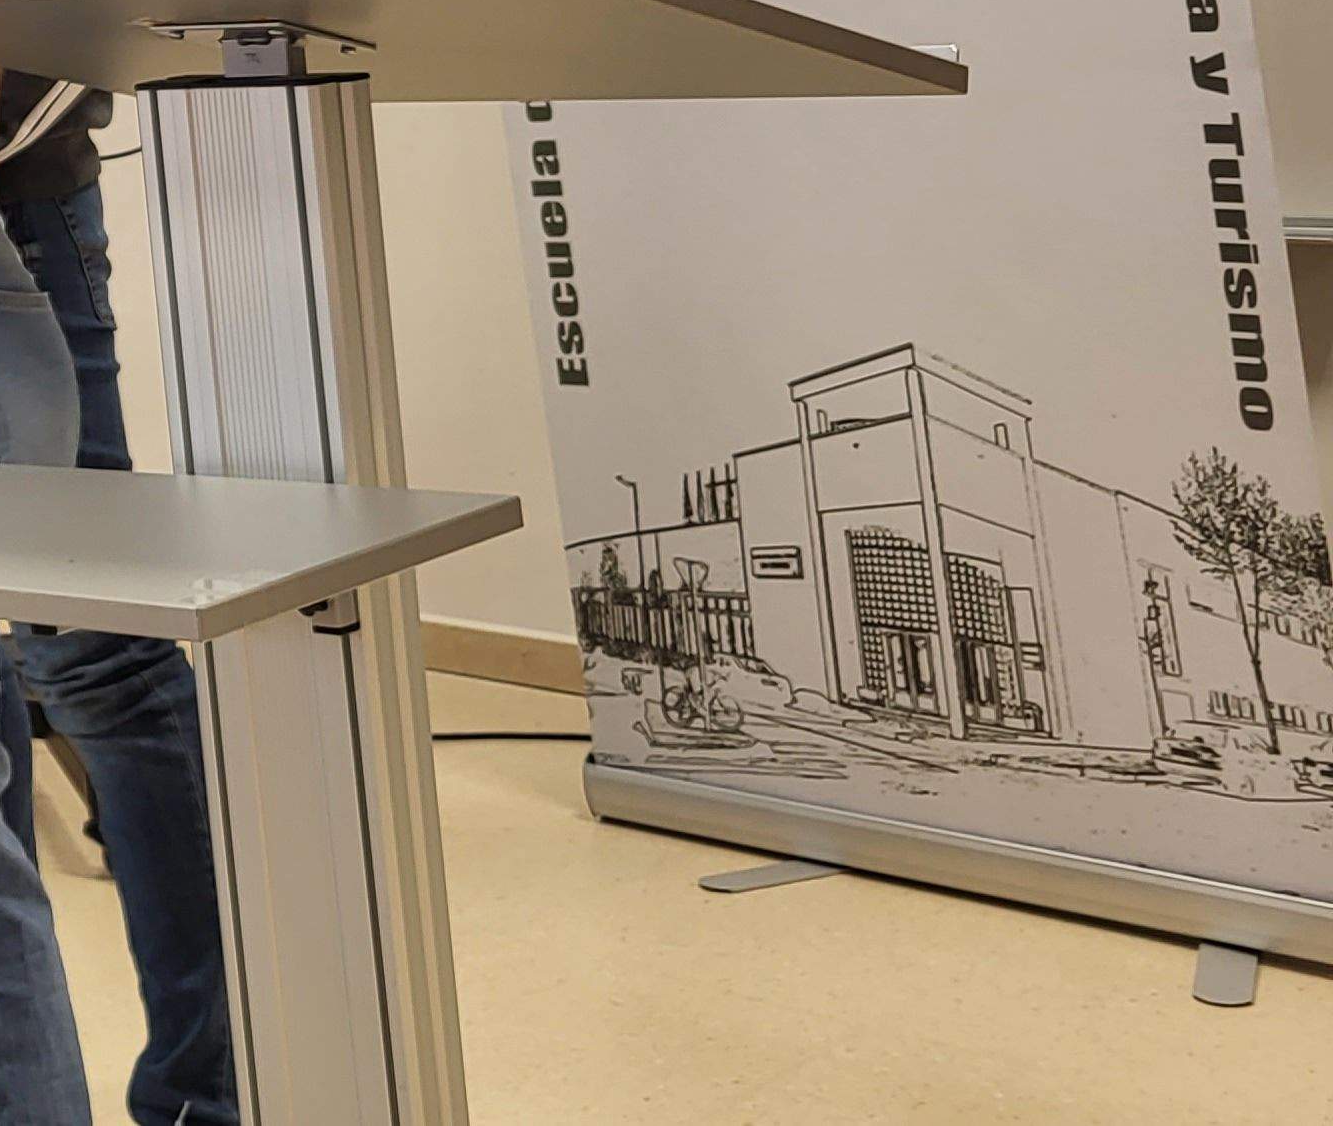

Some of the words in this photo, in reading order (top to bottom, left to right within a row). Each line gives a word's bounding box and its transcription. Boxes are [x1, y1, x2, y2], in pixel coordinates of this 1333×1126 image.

[1189, 51, 1230, 96] y
[531, 139, 590, 387] Escuela
[1202, 112, 1274, 432] Turismo
